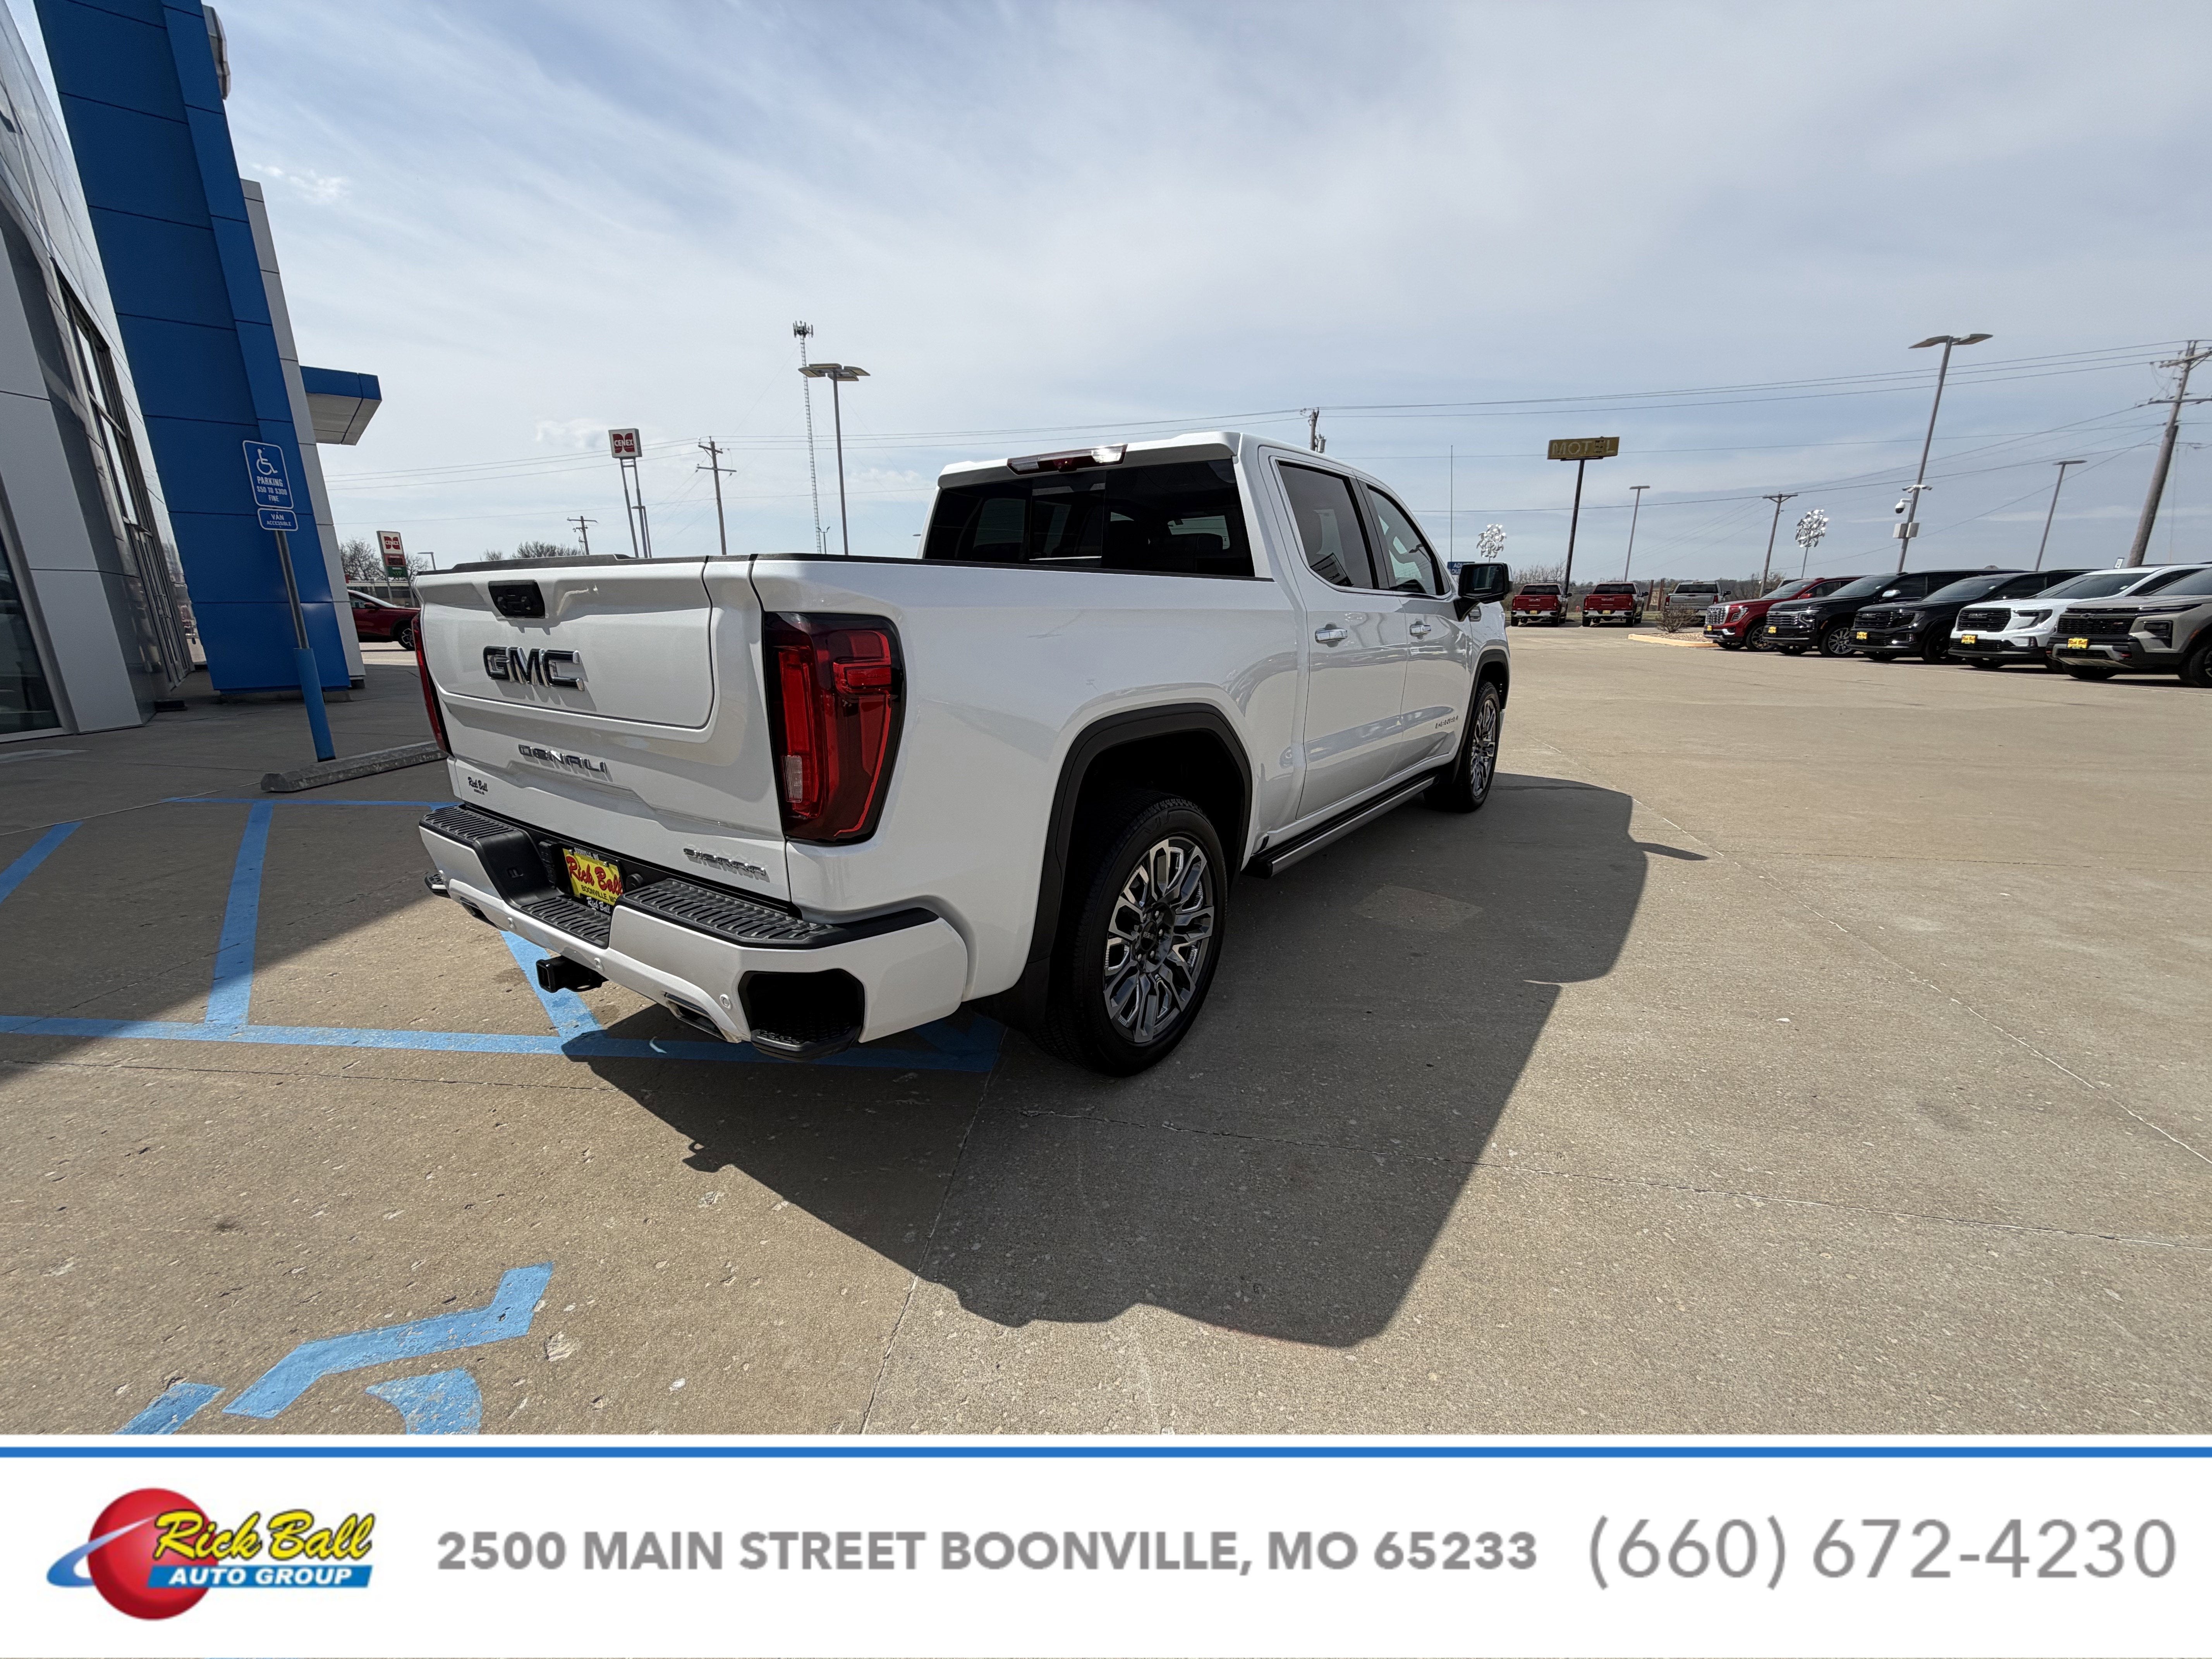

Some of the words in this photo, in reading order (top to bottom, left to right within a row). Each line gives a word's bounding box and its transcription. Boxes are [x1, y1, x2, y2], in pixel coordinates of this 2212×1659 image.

[1552, 440, 1615, 455] MOTEL
[257, 476, 283, 487] PARKING
[483, 646, 585, 691] GMC
[518, 744, 608, 773] DENALI
[566, 856, 594, 886] Rick
[594, 866, 623, 896] Ball
[683, 848, 766, 876] SIERRA
[586, 897, 599, 909] Rick
[599, 901, 611, 914] Ball
